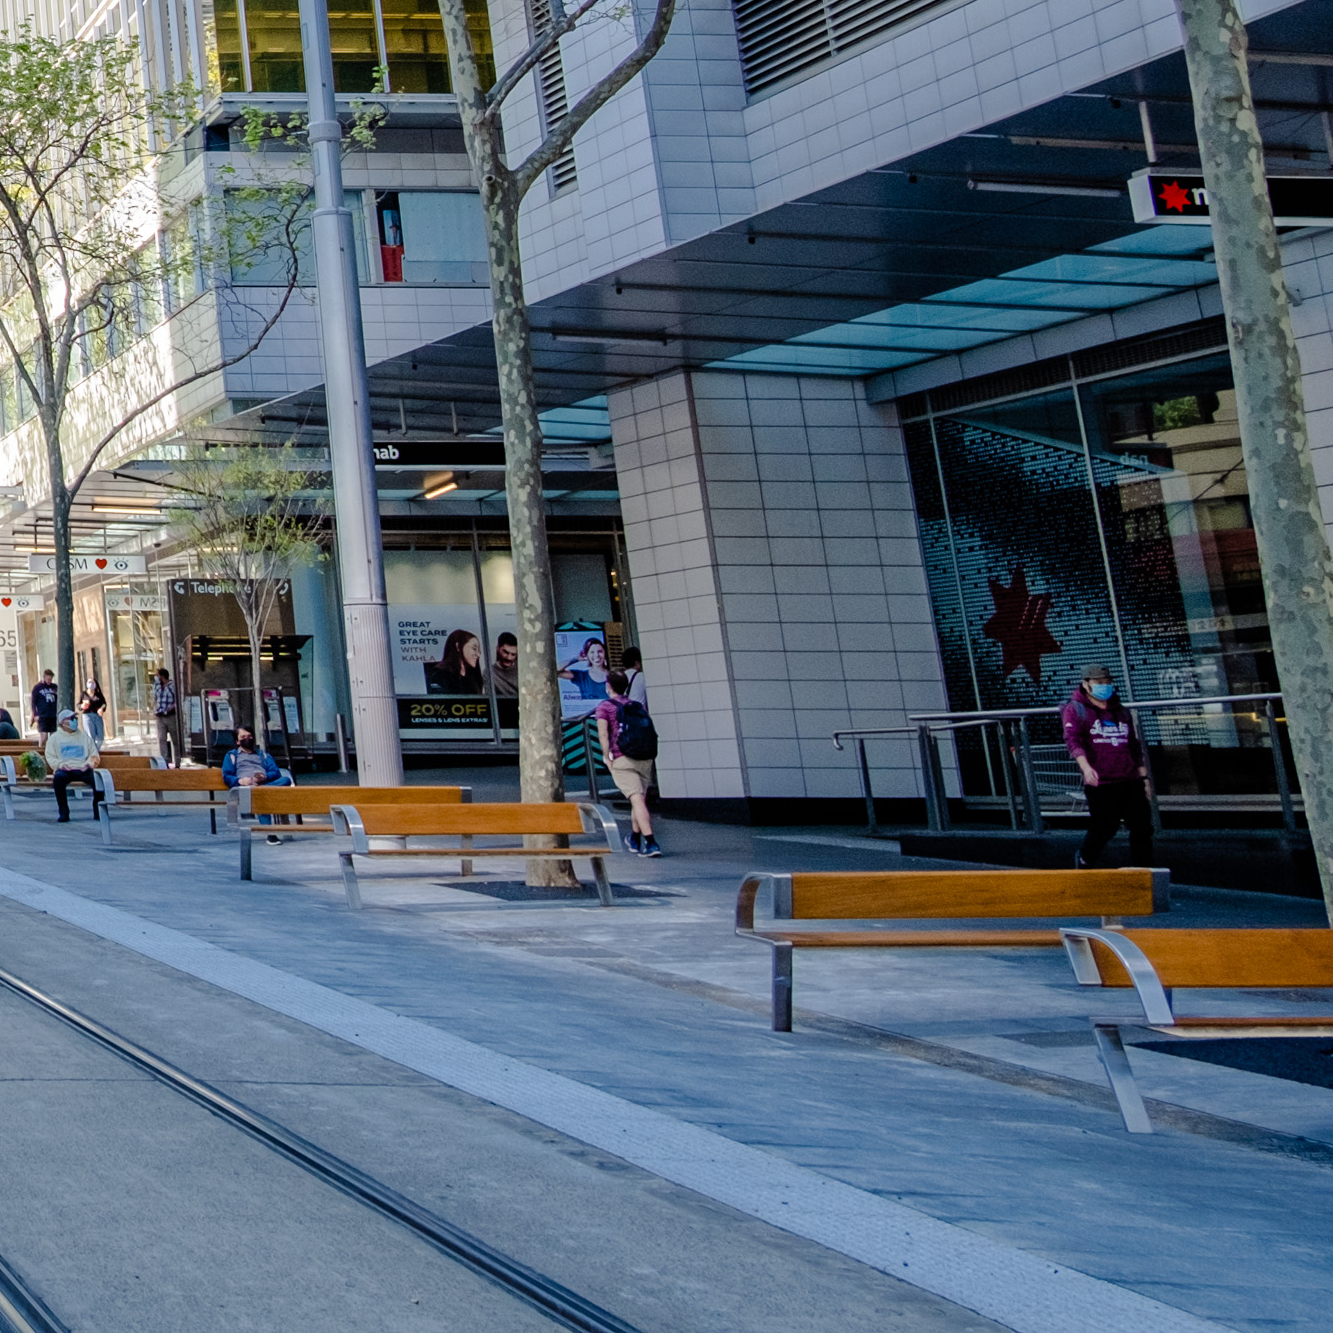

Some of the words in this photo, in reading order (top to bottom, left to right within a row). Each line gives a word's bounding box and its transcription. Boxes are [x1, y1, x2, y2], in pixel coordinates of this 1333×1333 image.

[46, 556, 88, 571] OSM
[399, 629, 418, 637] EYE
[401, 646, 427, 654] WITH
[410, 704, 448, 716] 20%
[451, 704, 487, 715] OFF
